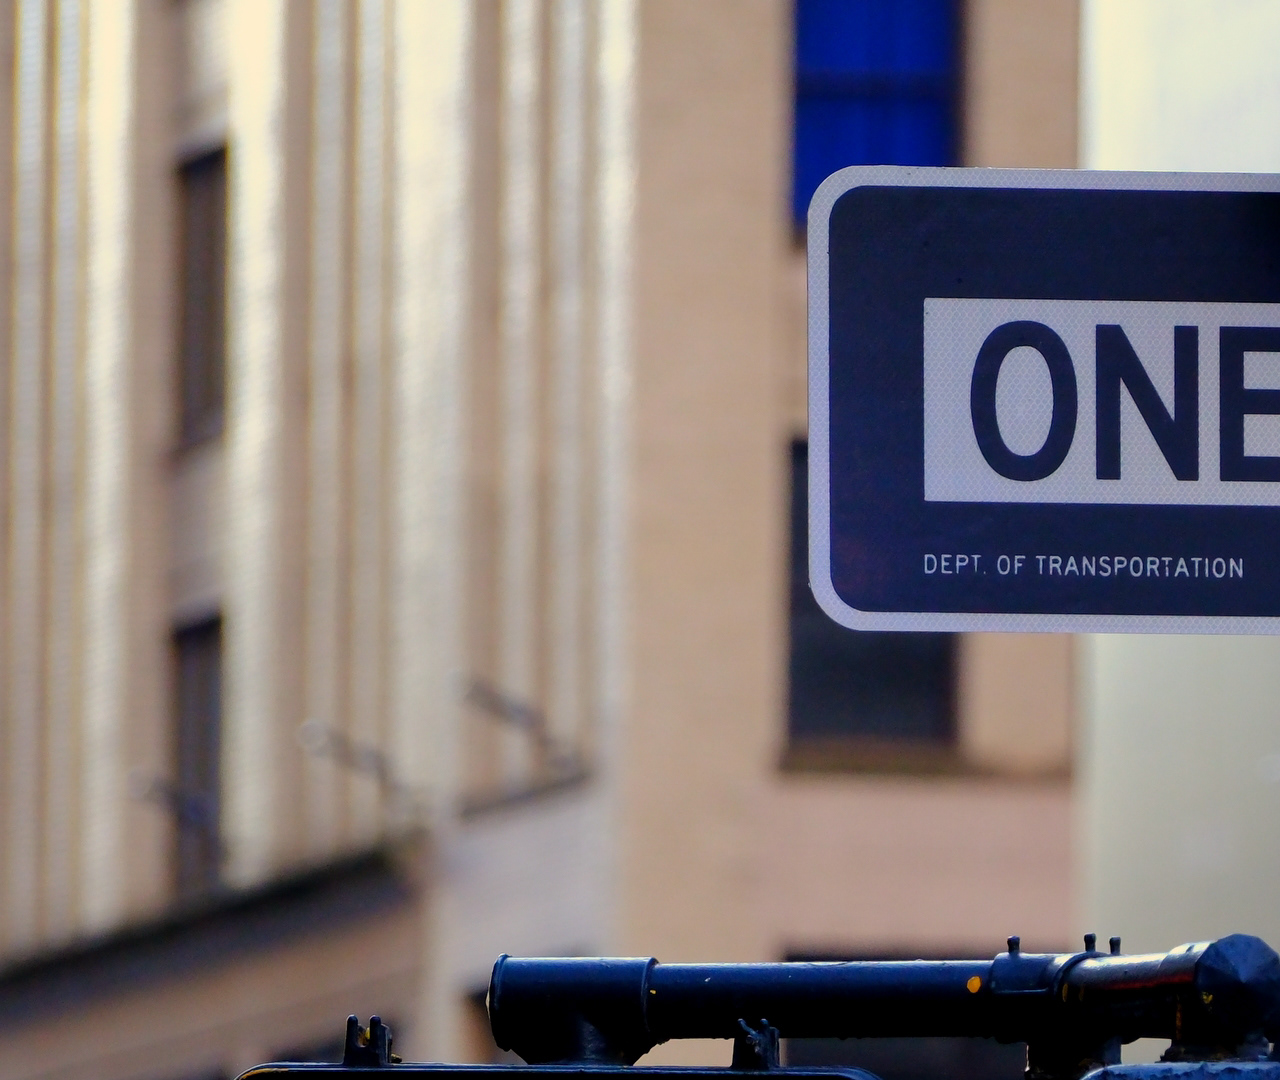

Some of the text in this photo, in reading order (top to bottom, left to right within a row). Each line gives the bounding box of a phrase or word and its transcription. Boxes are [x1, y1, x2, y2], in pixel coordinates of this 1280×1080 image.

[924, 553, 1244, 579] DEPT. OF TRANSPORTATION
